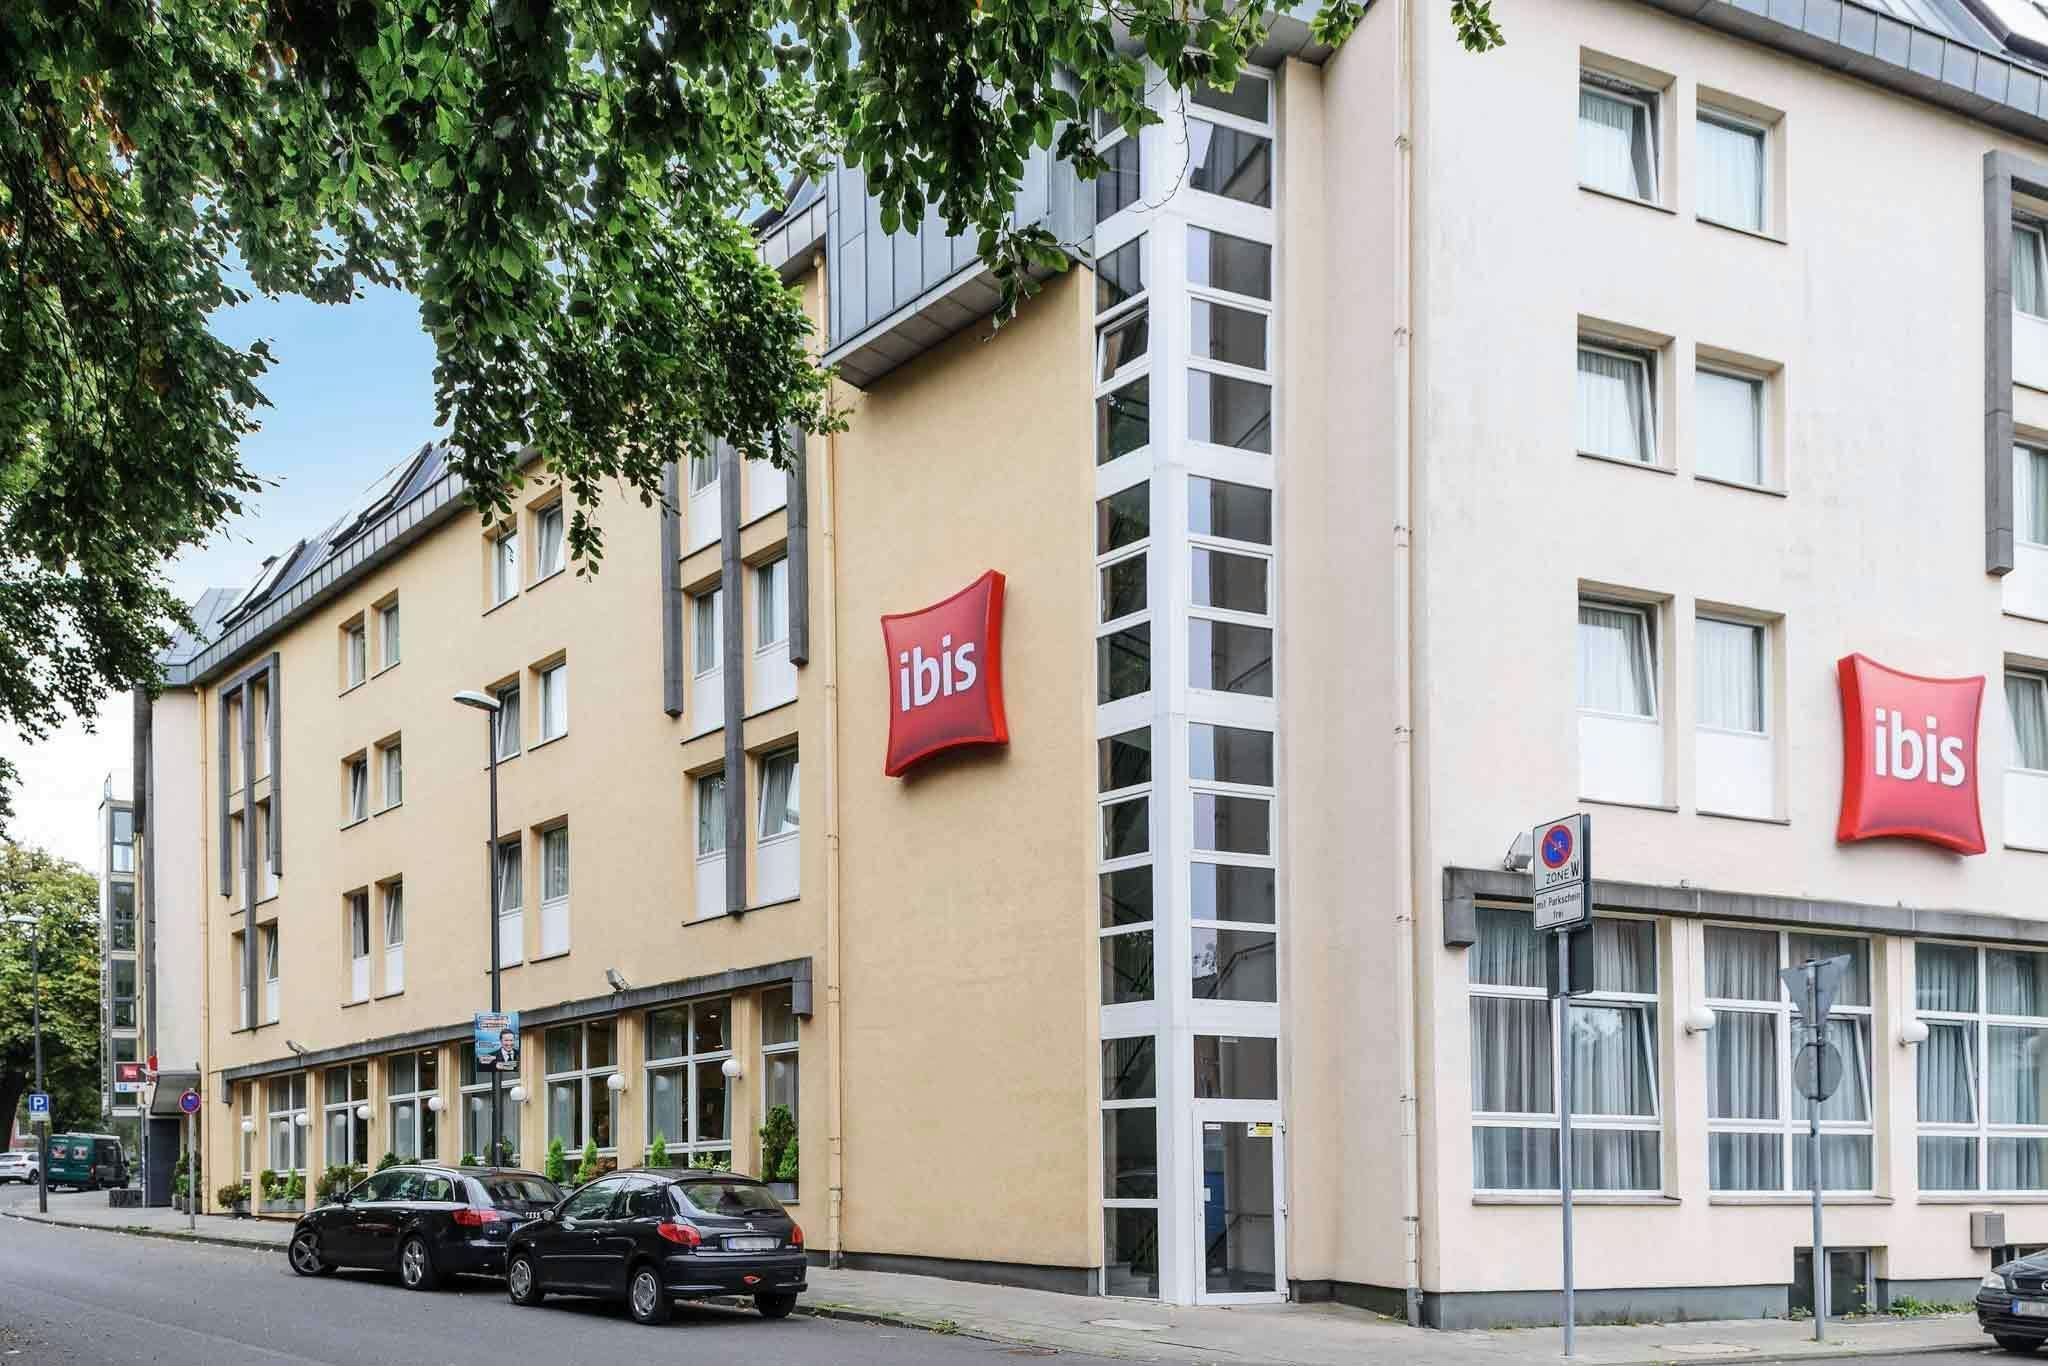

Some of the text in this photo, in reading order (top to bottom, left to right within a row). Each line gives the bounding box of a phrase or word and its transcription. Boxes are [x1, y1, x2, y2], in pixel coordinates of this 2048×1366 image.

[899, 632, 977, 712] ibis
[1874, 707, 1966, 788] ibis
[1546, 861, 1580, 885] ZONE W
[33, 1097, 44, 1110] P
